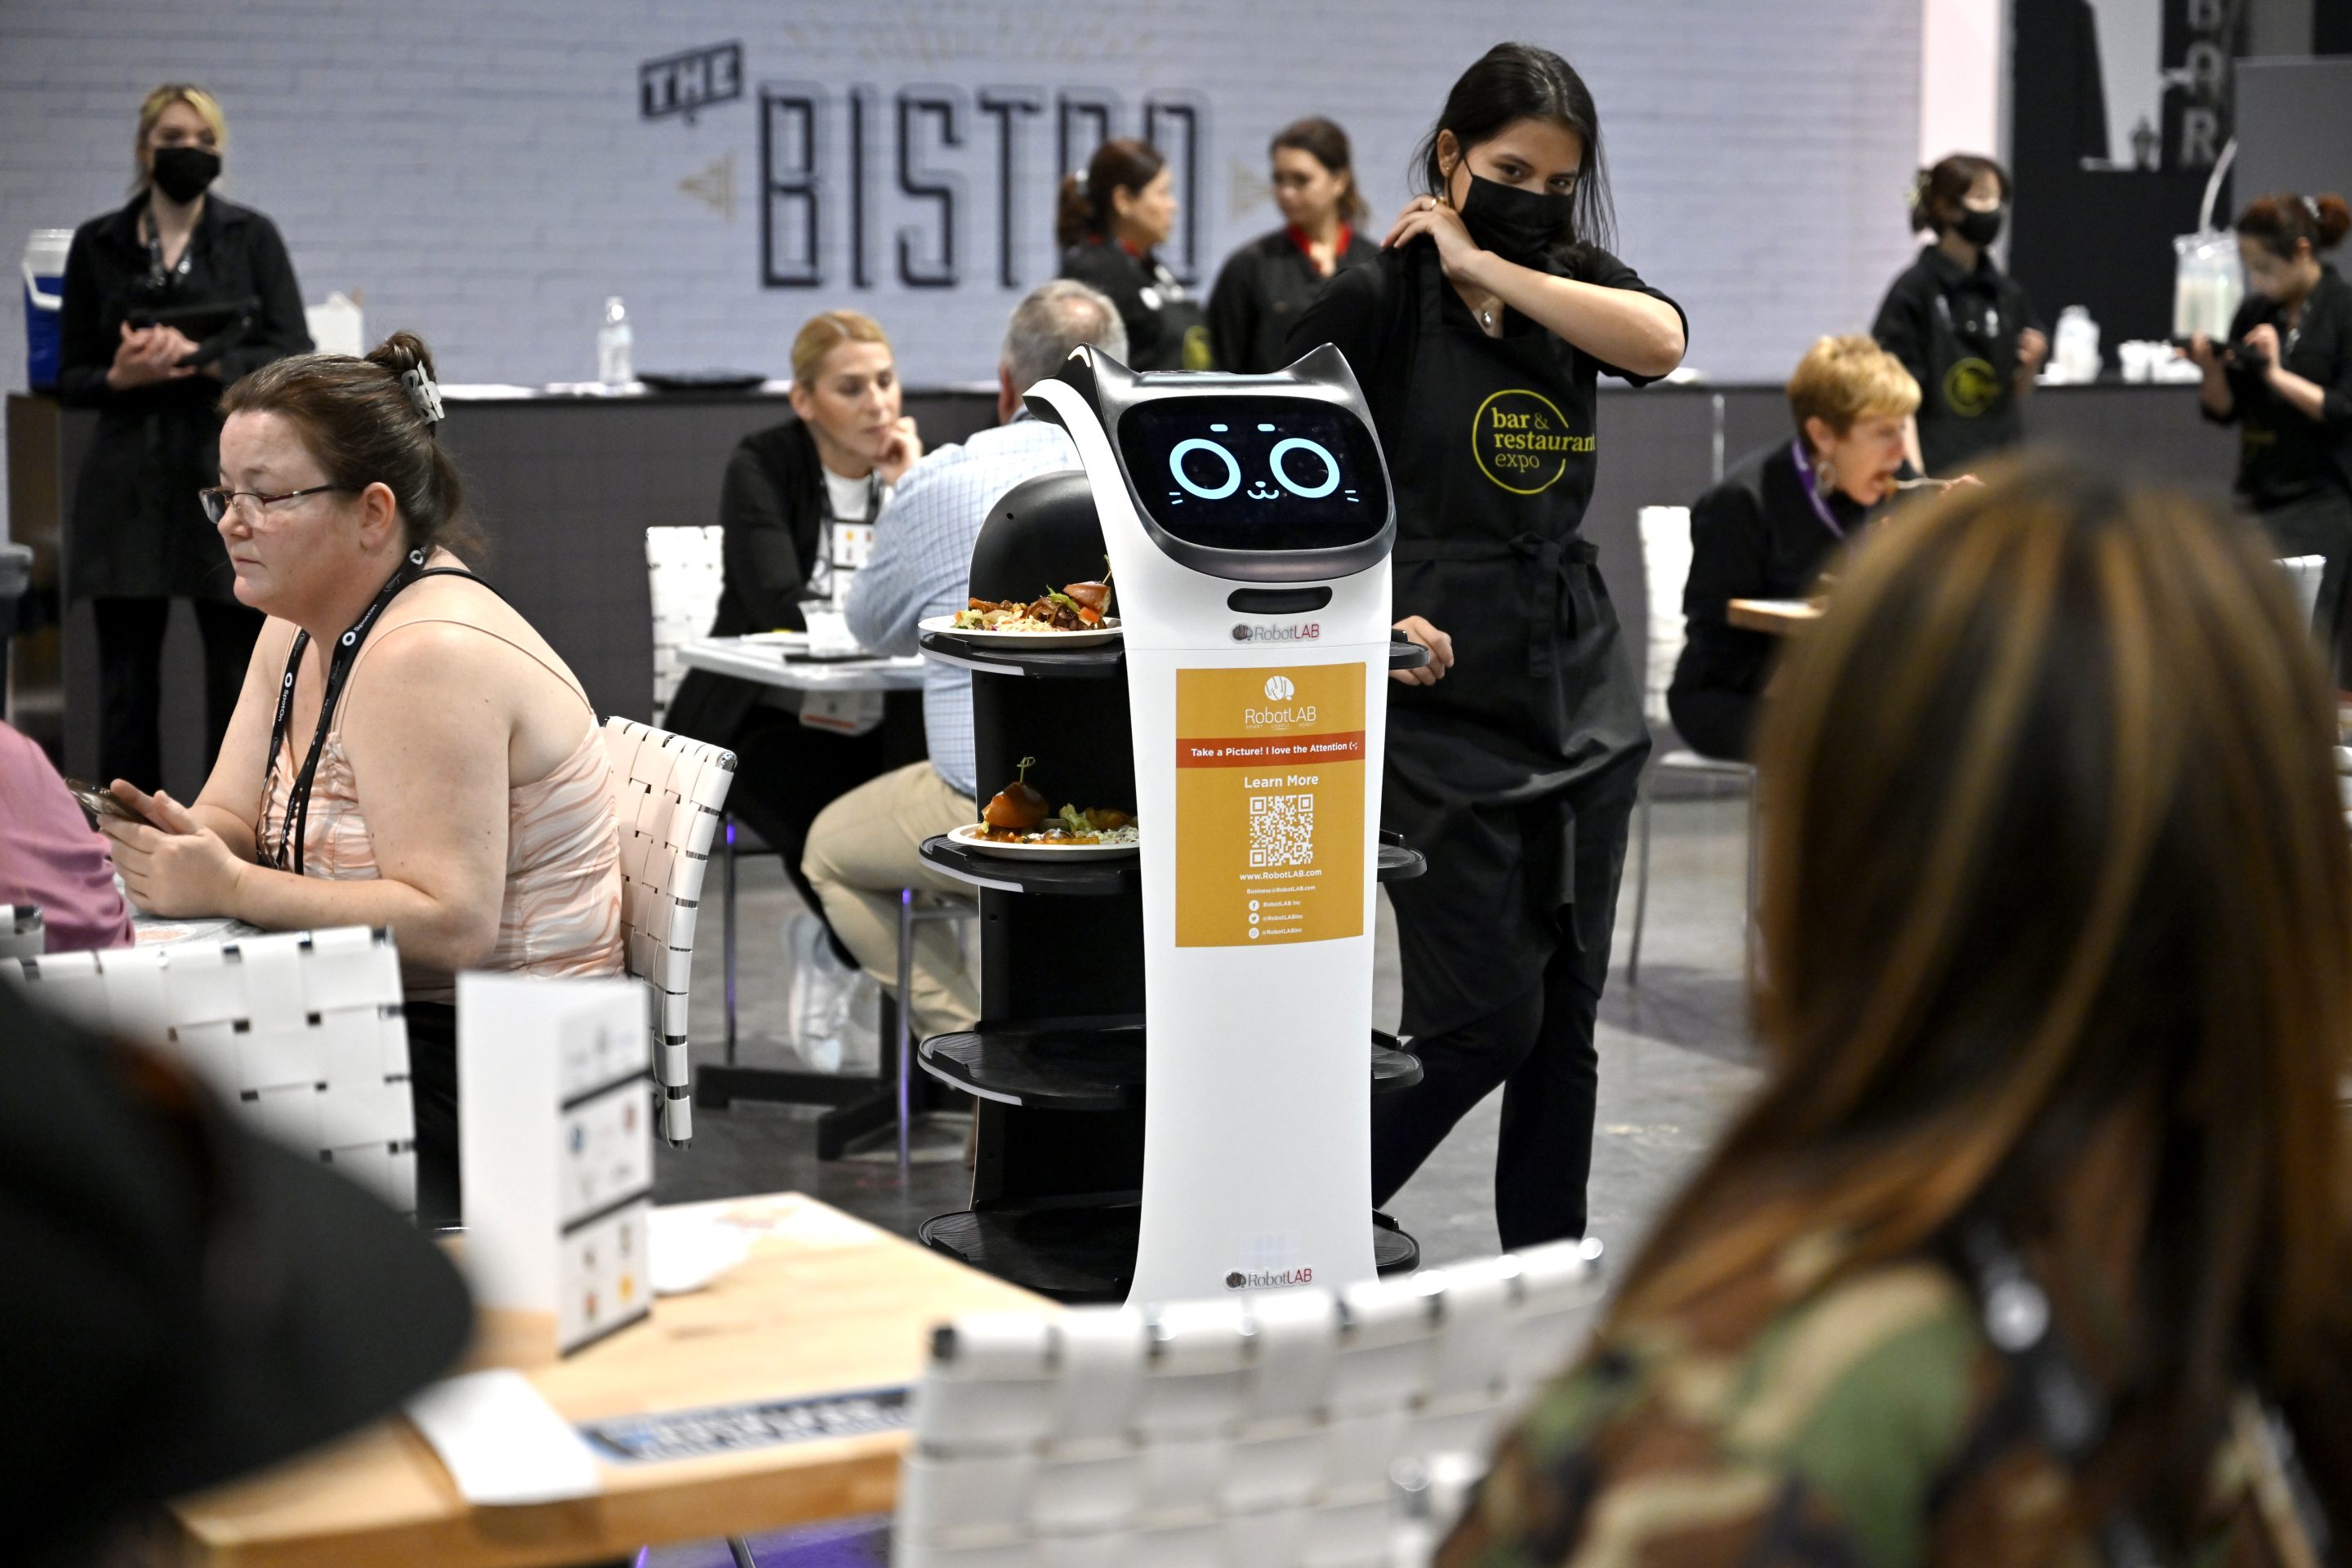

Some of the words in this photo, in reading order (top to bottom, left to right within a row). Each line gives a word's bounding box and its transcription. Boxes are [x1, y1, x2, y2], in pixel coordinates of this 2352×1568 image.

[644, 47, 738, 113] THE
[1491, 407, 1530, 428] bar
[1535, 412, 1550, 430] &
[1494, 431, 1596, 452] restauran
[1494, 453, 1540, 473] expo
[354, 604, 377, 631] SpotOn
[1254, 624, 1320, 640] RobotLAB
[278, 689, 289, 721] SpotOn
[1245, 706, 1316, 724] RobotLAB
[1191, 748, 1214, 756] Take
[1225, 746, 1263, 756] Picture!
[1272, 746, 1290, 755] love
[1293, 745, 1307, 753] the
[1310, 742, 1348, 752] Attention
[1244, 777, 1283, 788] Learn
[1287, 775, 1319, 786] More
[1240, 869, 1322, 880] www.RobotLAB.com
[1248, 1268, 1312, 1287] RobotLAB
